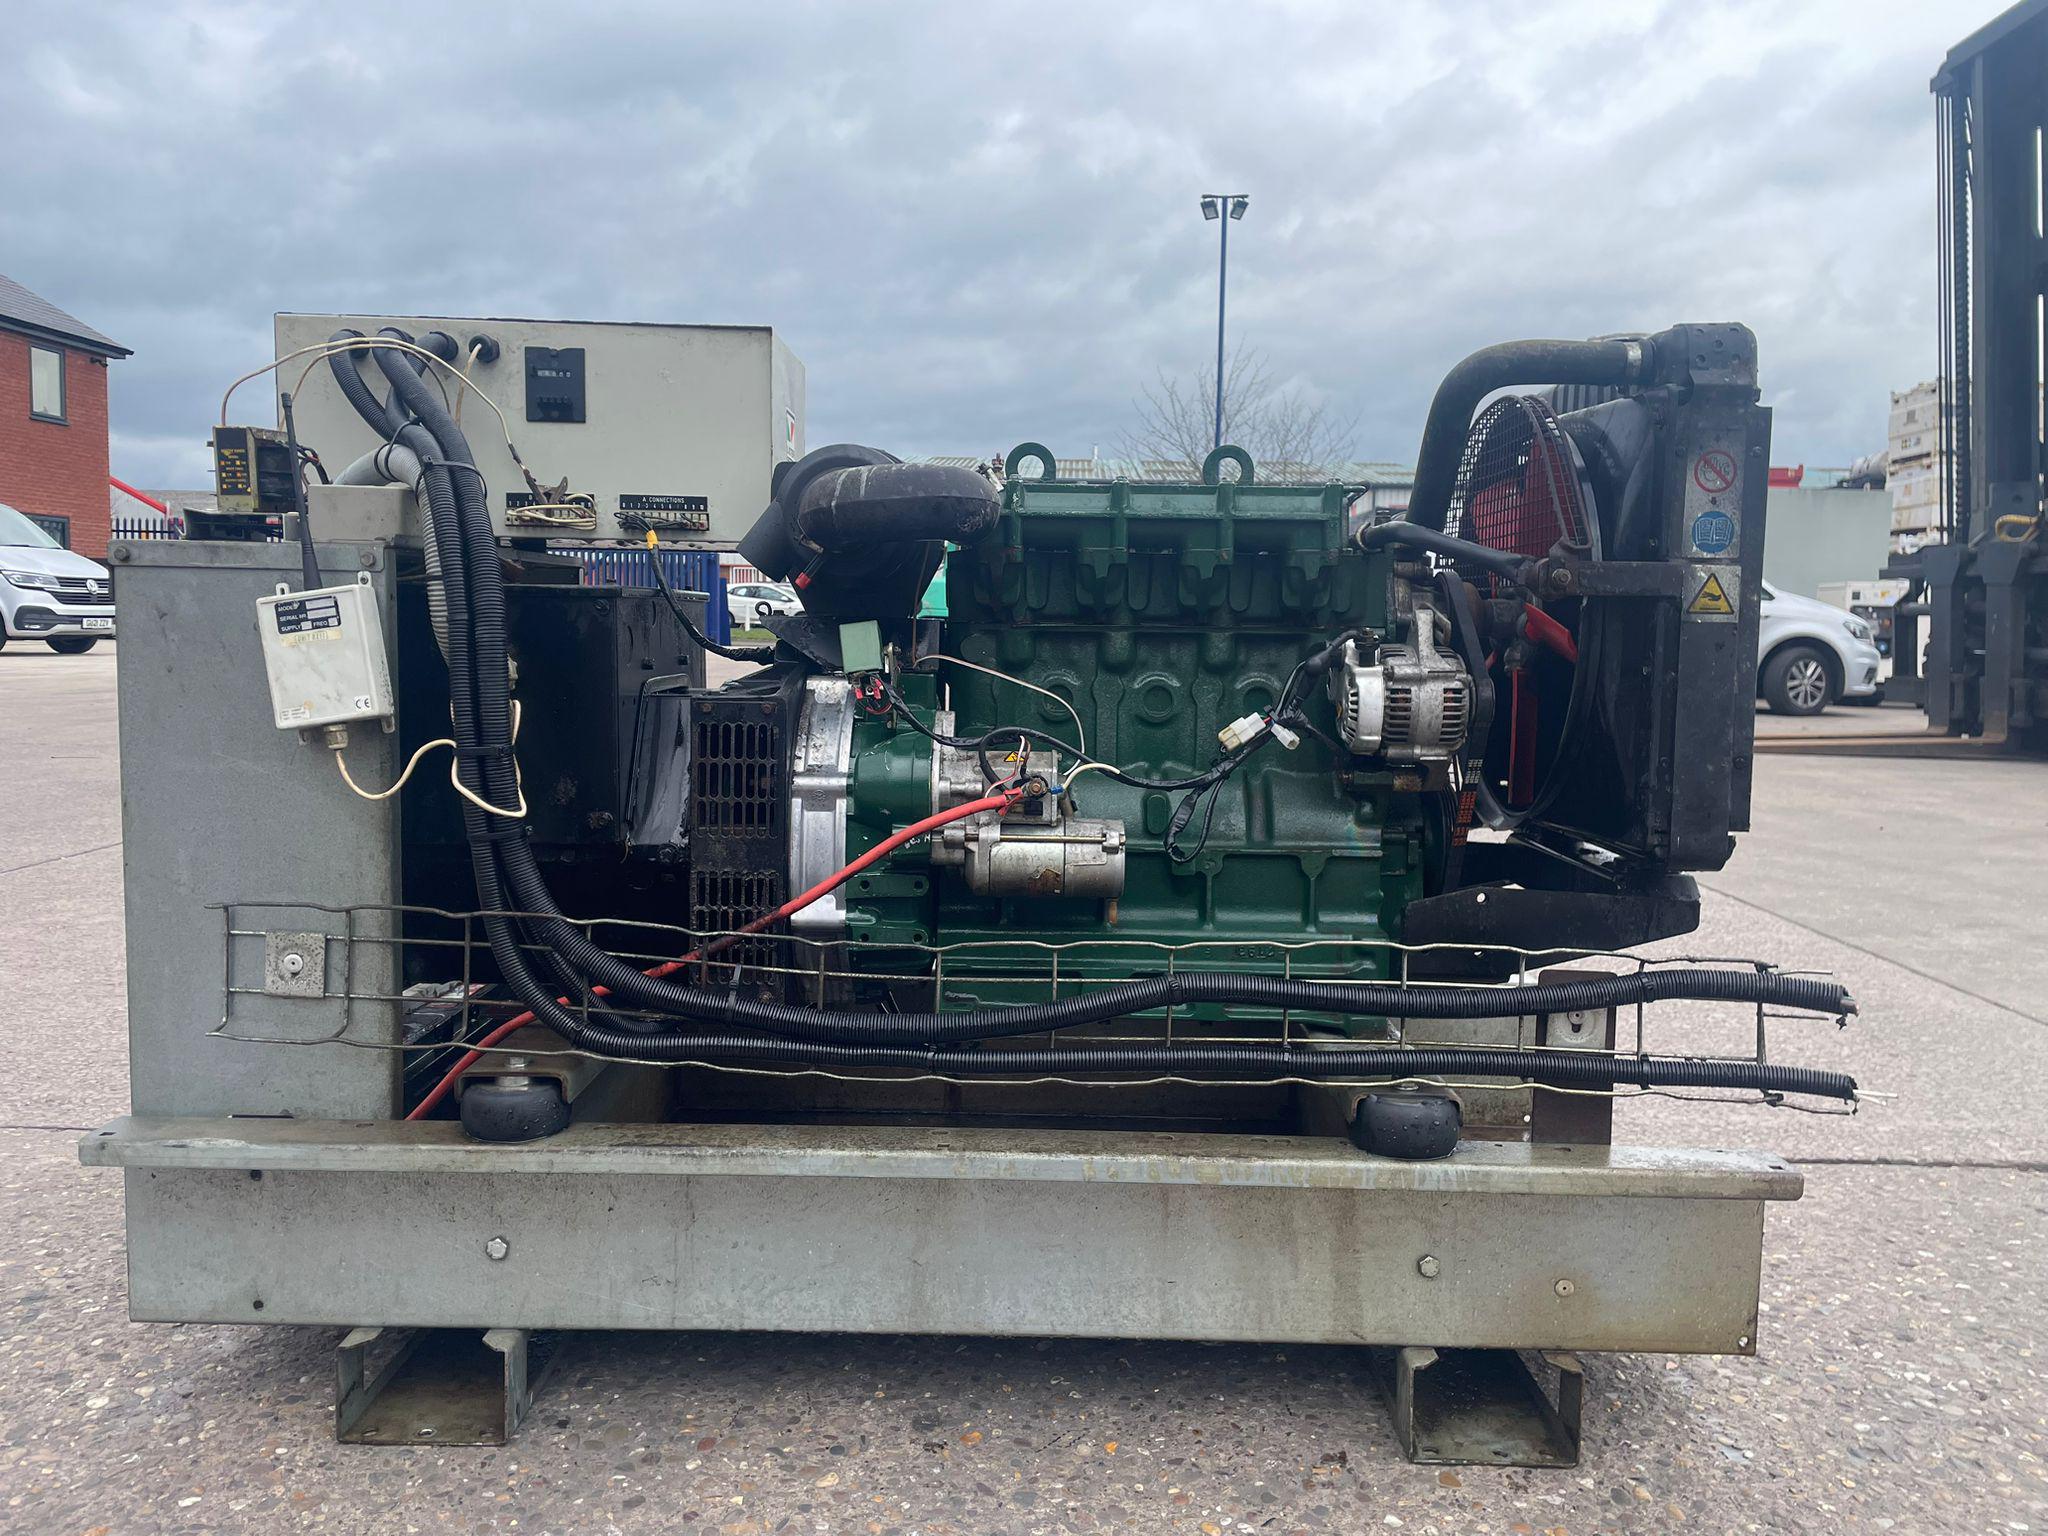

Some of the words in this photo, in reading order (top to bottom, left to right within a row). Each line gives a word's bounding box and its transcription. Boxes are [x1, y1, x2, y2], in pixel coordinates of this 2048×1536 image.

[649, 496, 685, 504] CONNECTIONS
[279, 614, 299, 622] SERIAL
[280, 624, 302, 632] SUPPLY
[355, 698, 370, 710] CE
